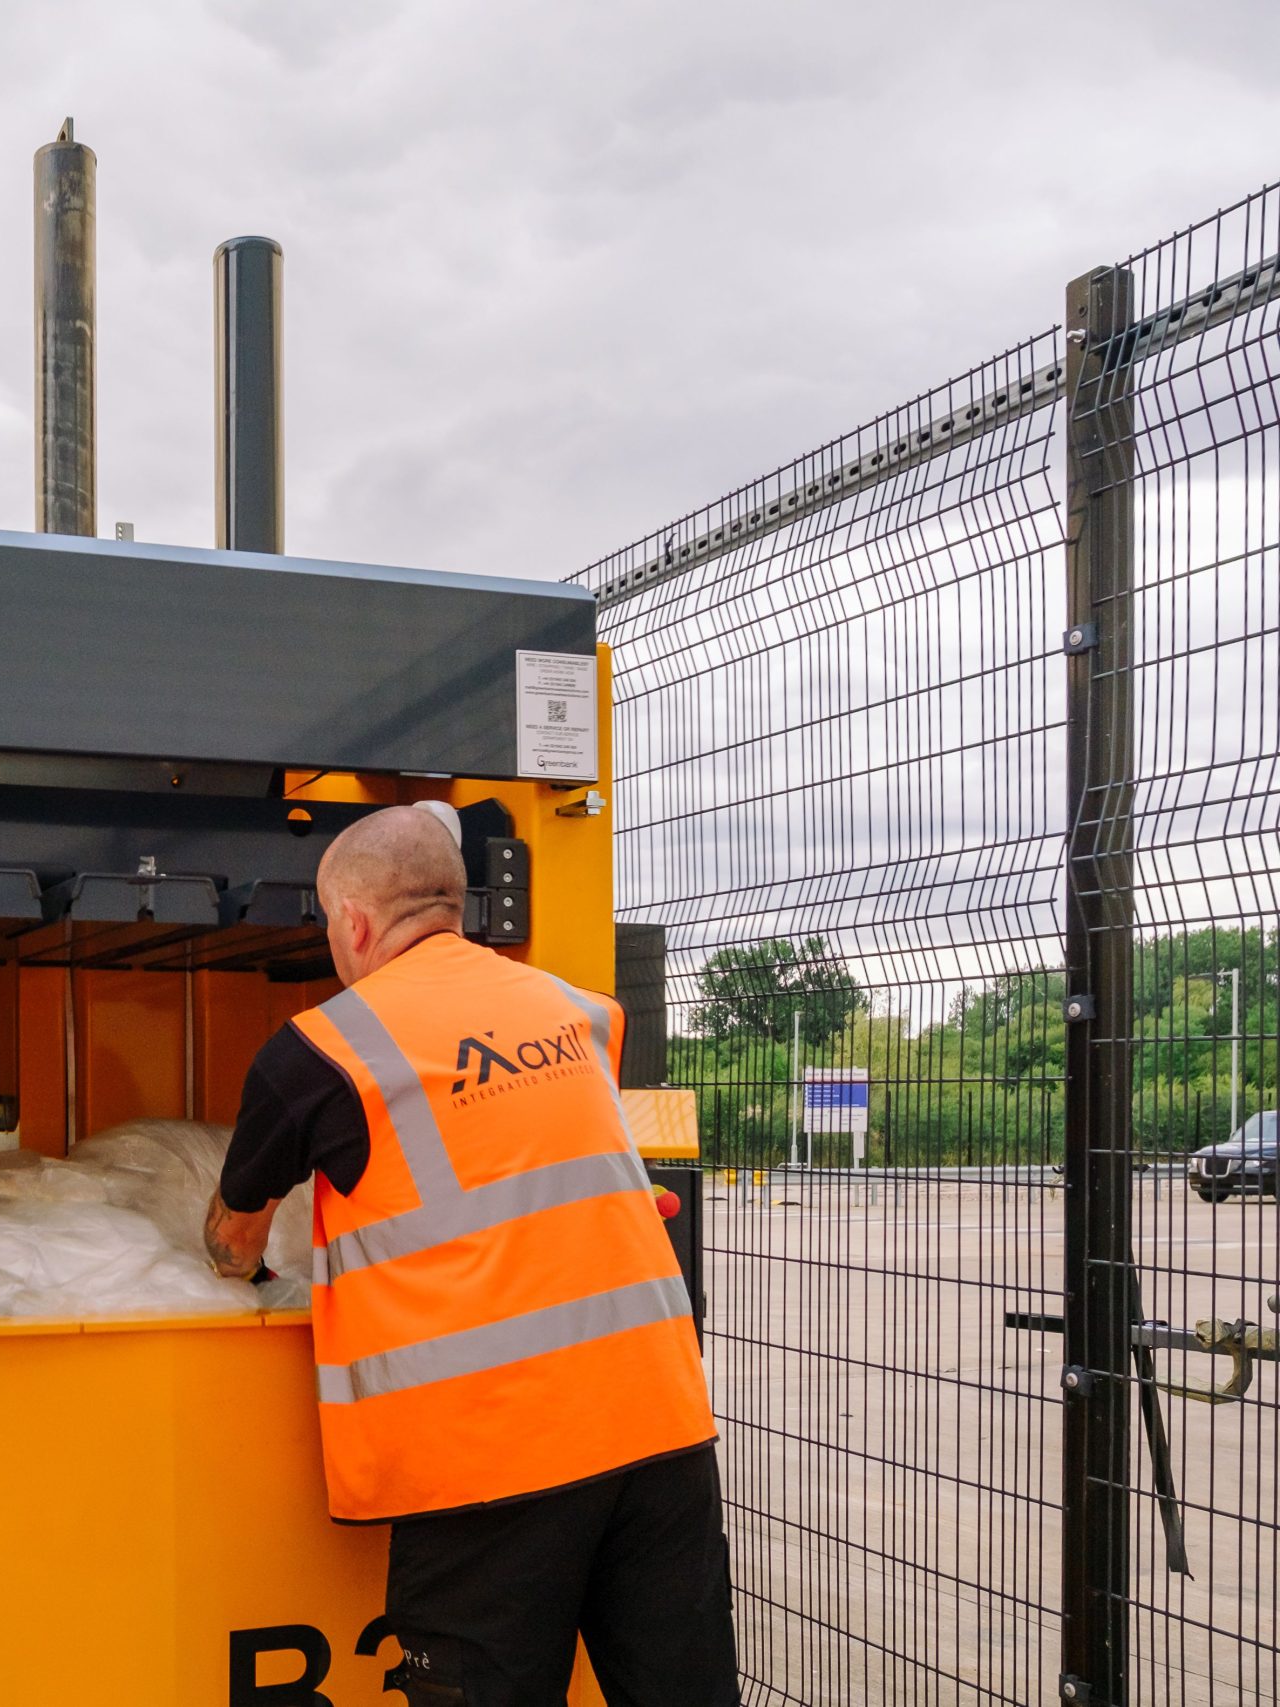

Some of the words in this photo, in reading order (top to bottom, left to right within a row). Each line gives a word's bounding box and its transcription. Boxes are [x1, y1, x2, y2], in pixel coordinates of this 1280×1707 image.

[537, 755, 578, 771] Greenbank
[452, 1075, 539, 1110] INTEGRATED
[545, 1065, 594, 1081] SERVICES
